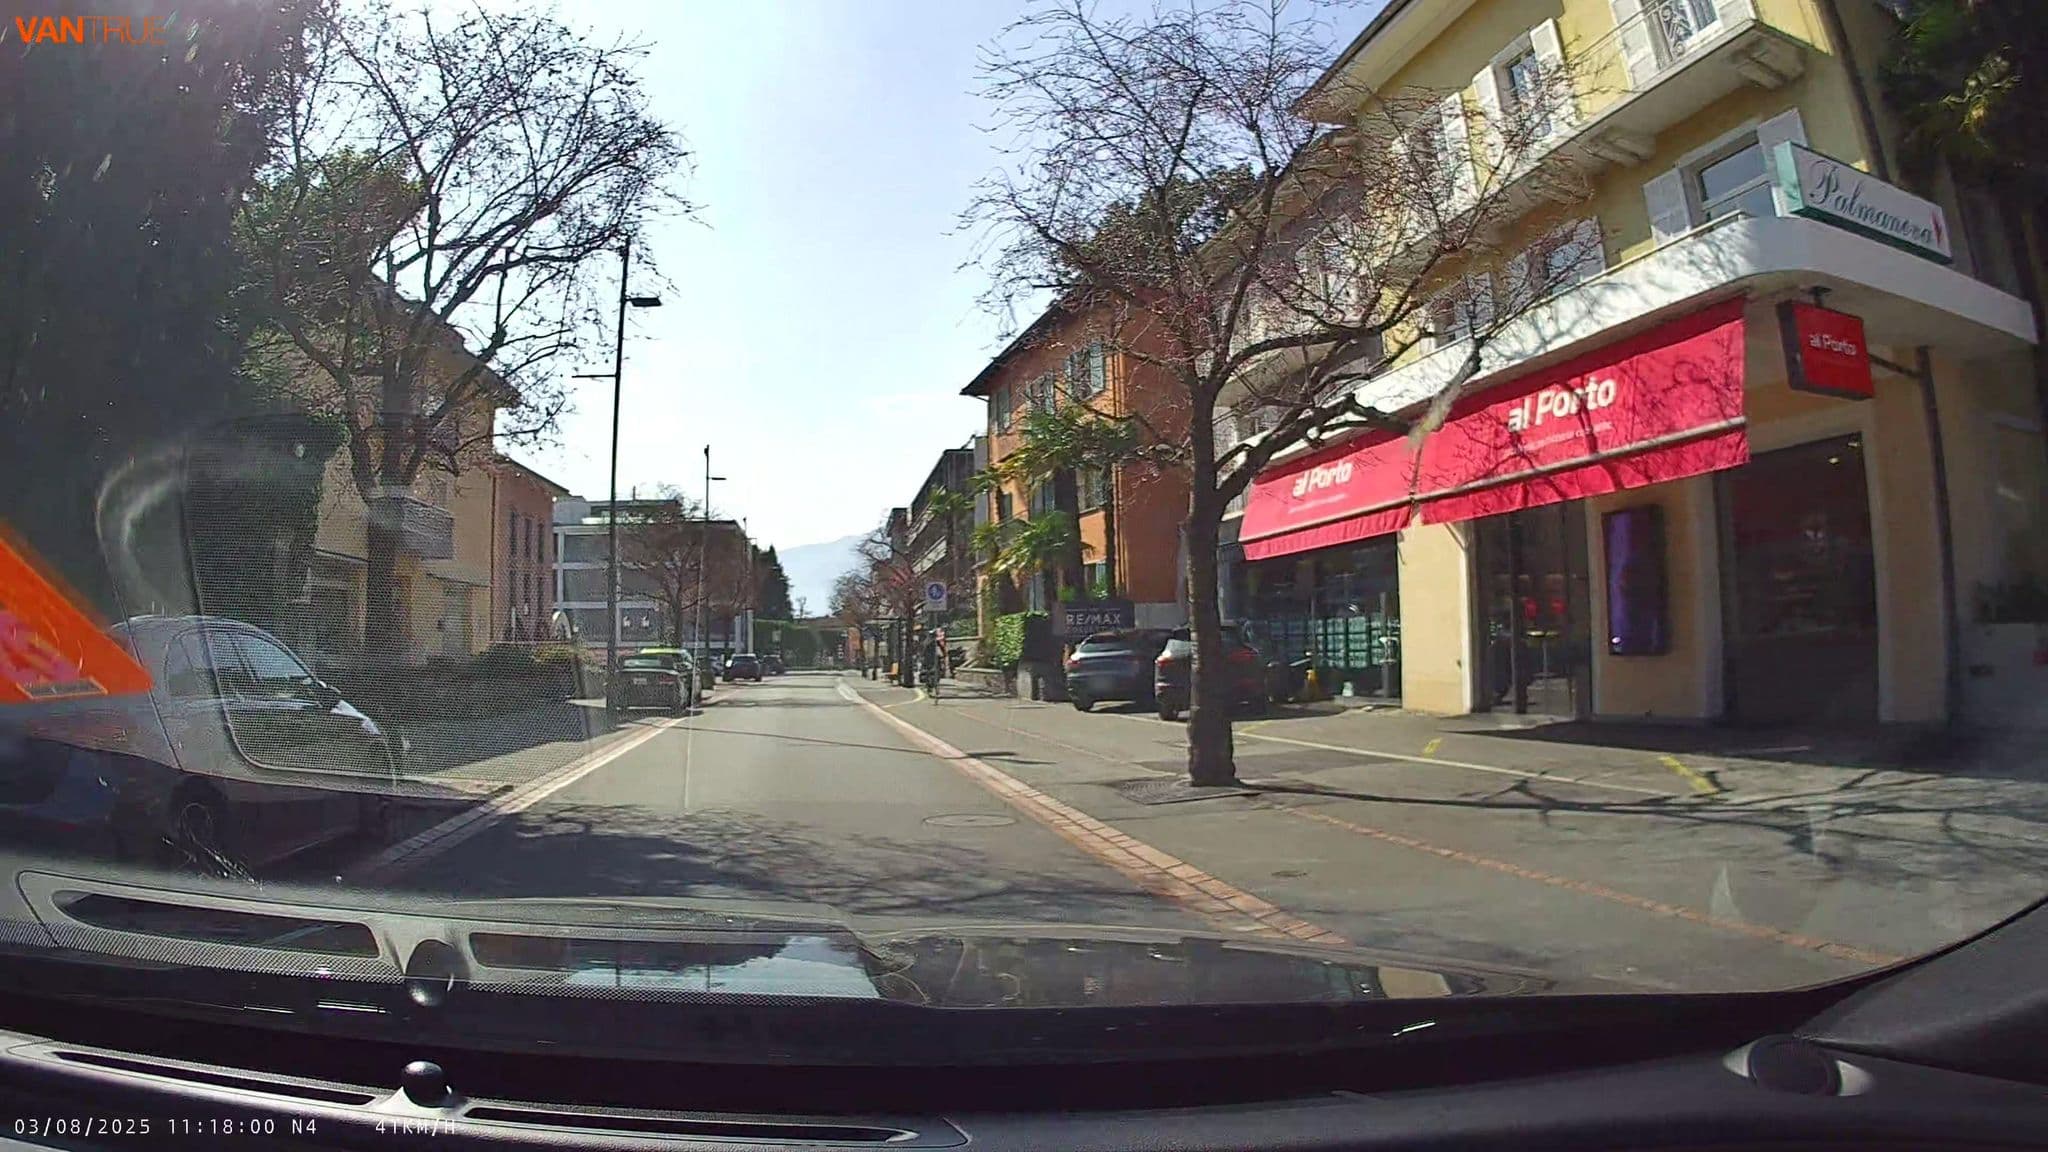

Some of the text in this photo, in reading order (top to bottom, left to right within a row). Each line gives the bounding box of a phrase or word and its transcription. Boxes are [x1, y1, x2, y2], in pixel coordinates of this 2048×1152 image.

[1809, 159, 1934, 244] Palmanova
[1809, 333, 1857, 356] al Porto
[1508, 376, 1617, 433] al Porto
[1292, 459, 1354, 498] al Porto
[1066, 613, 1121, 626] RE/MAX
